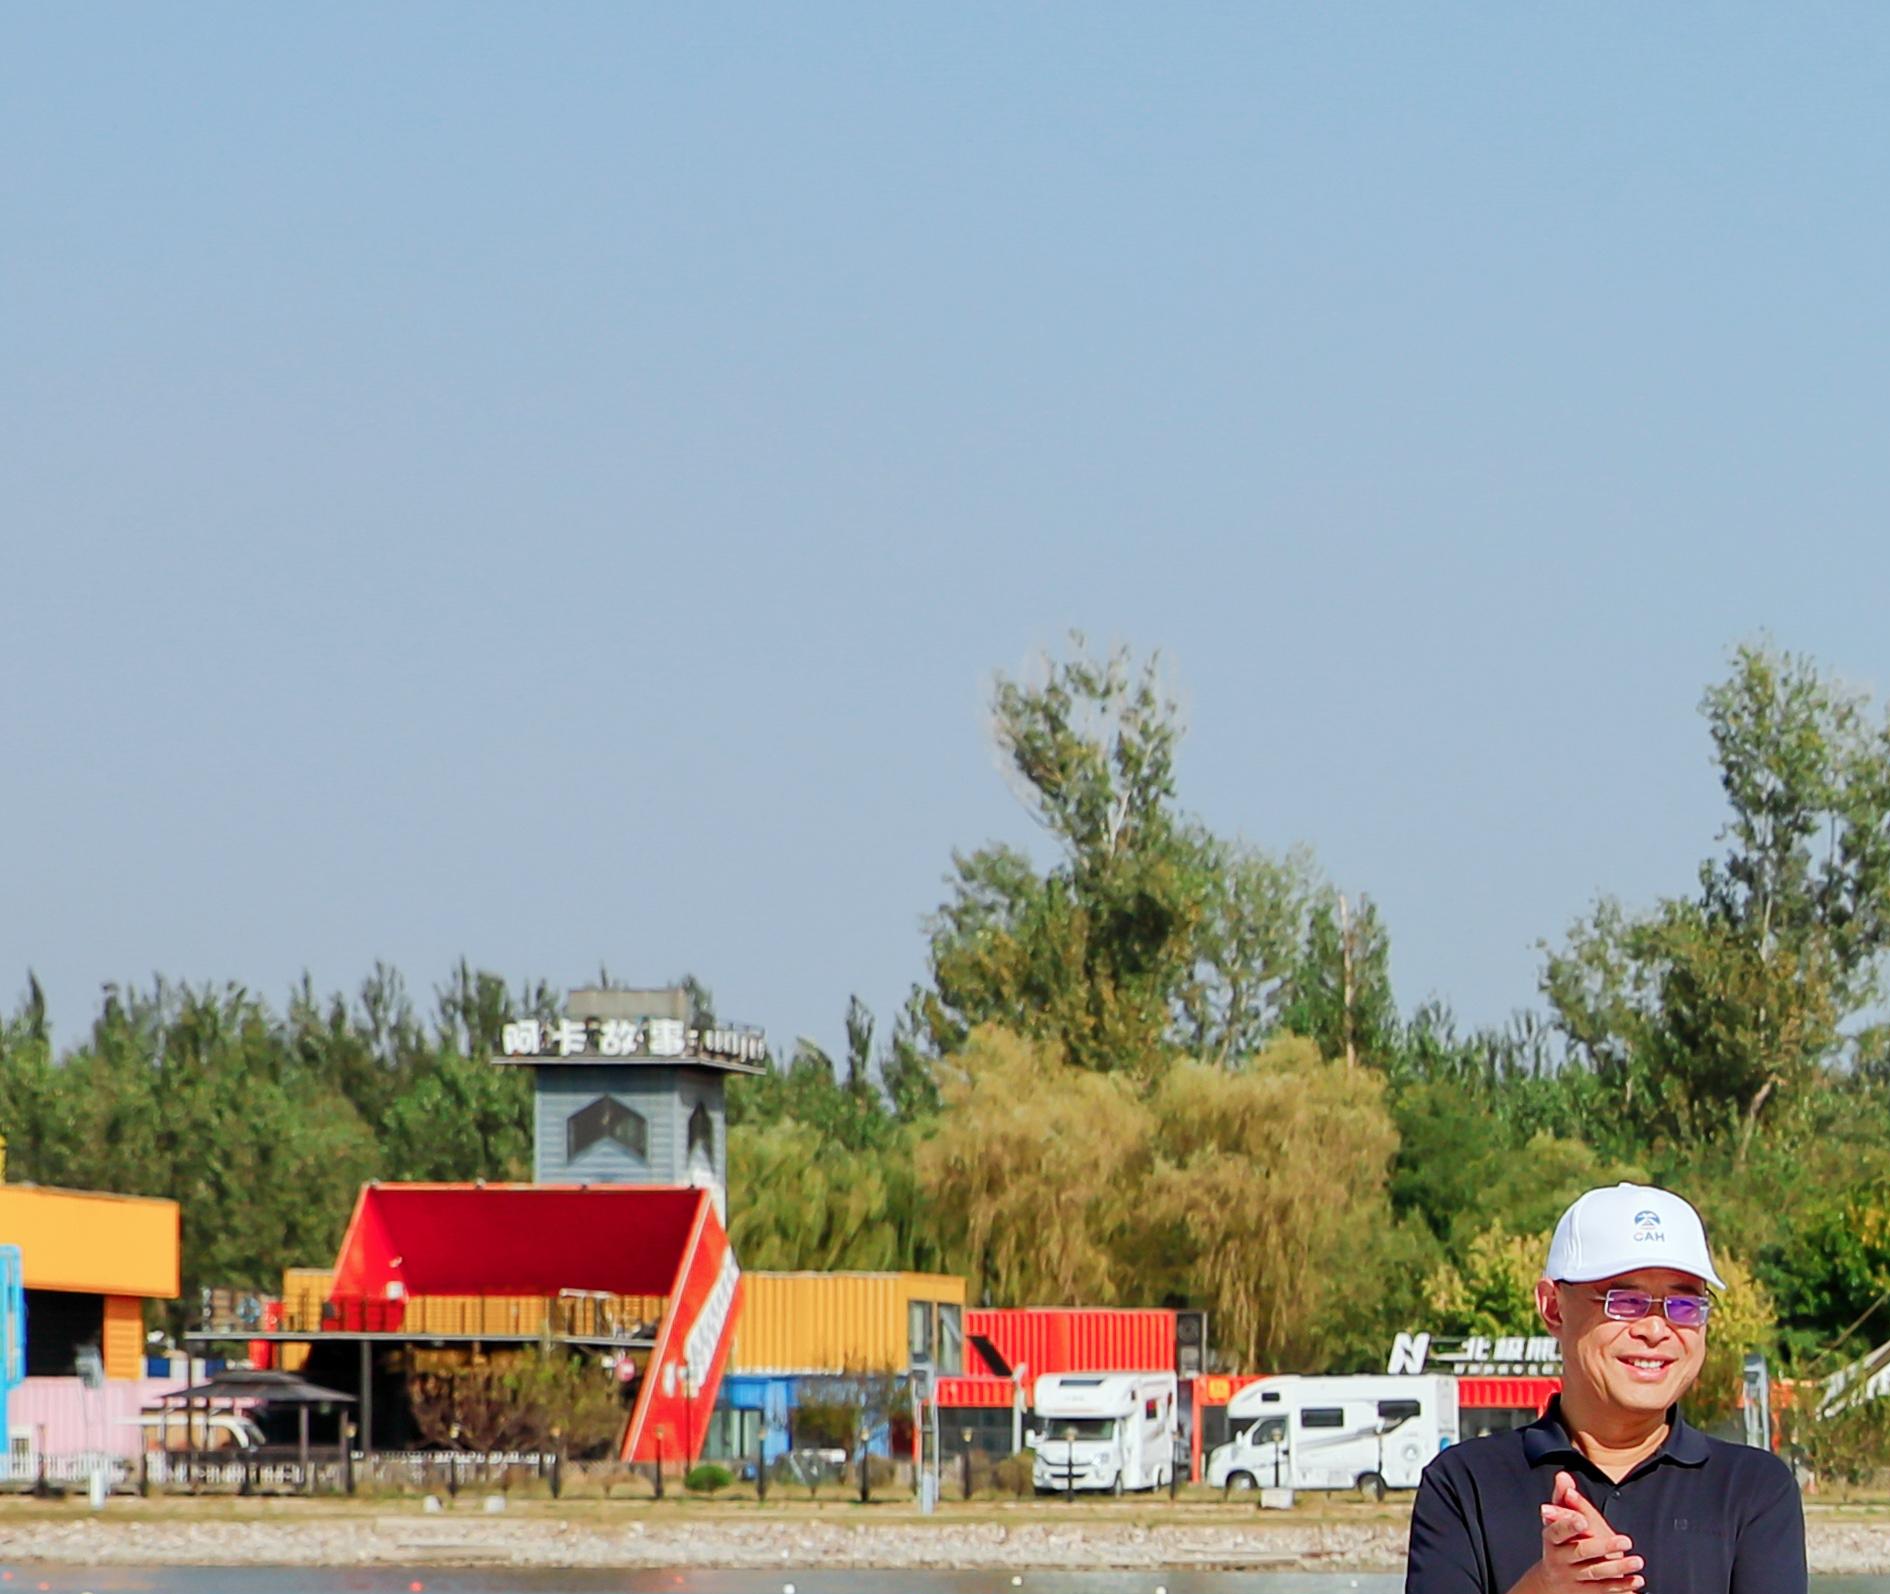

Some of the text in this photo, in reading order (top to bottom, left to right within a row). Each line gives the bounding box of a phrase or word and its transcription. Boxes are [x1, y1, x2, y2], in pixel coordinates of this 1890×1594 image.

[503, 1019, 684, 1056] 阿卡故事
[1633, 1231, 1666, 1242] CAH
